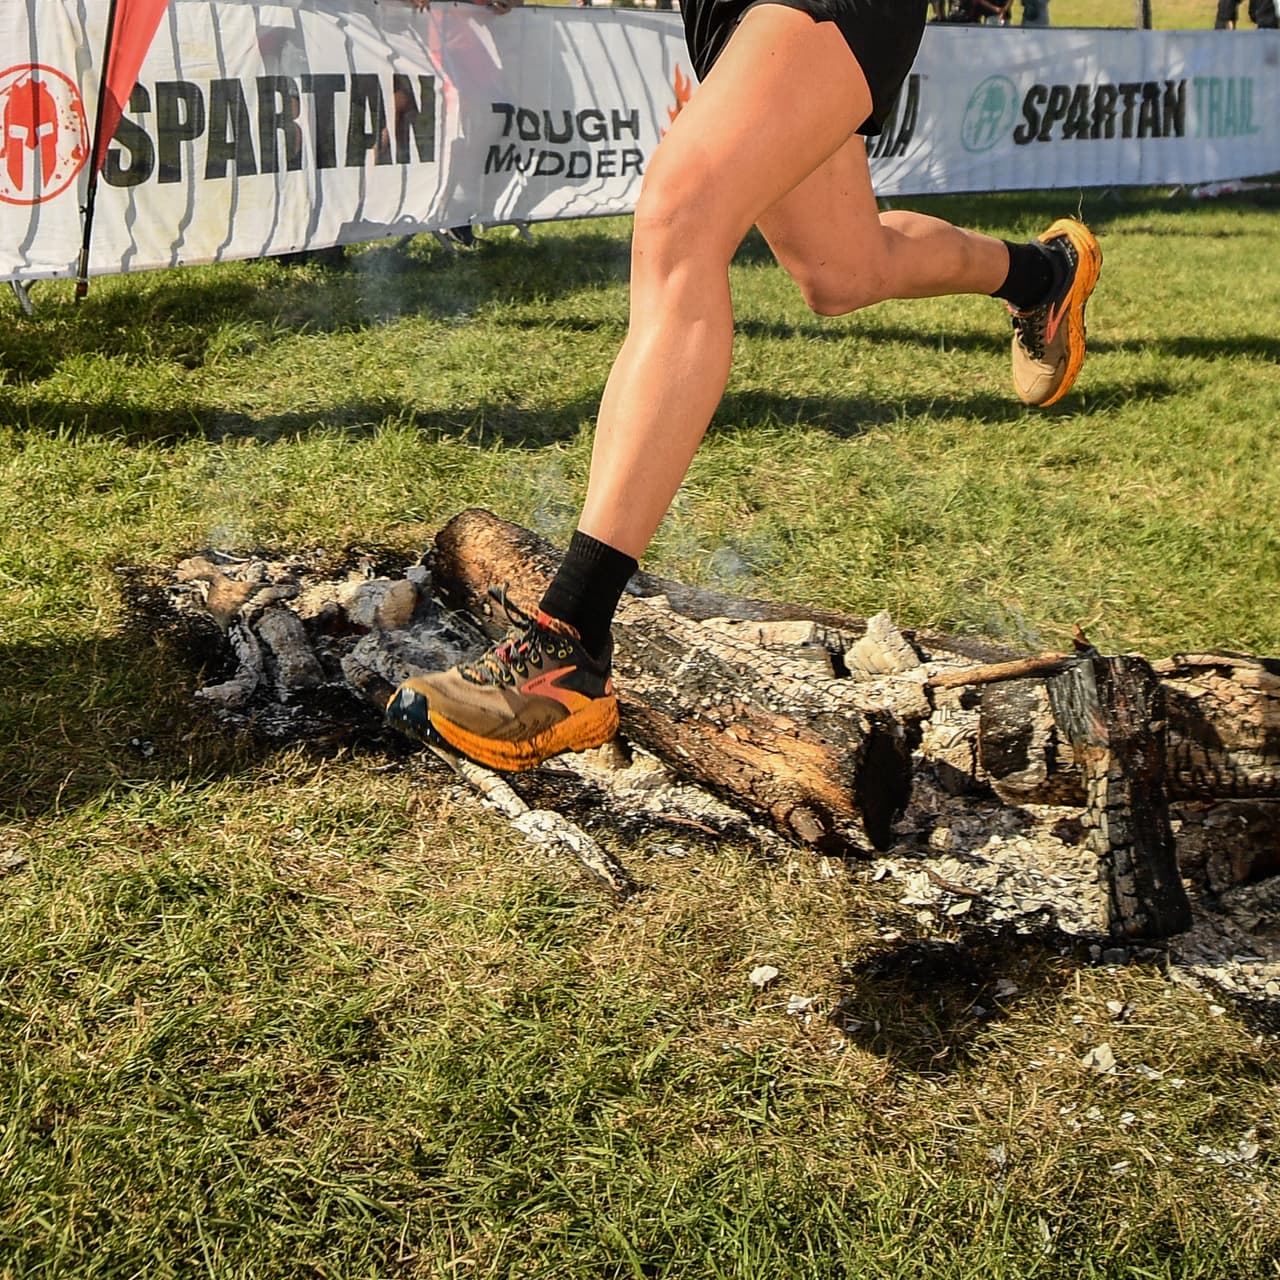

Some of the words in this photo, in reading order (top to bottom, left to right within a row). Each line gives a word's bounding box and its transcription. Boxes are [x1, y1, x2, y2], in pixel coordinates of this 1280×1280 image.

[102, 73, 436, 187] SPARTAN
[491, 103, 640, 144] TOUGH
[1013, 78, 1187, 145] SPARTAN
[1193, 76, 1263, 138] TRAIL
[484, 143, 645, 179] MUDDER
